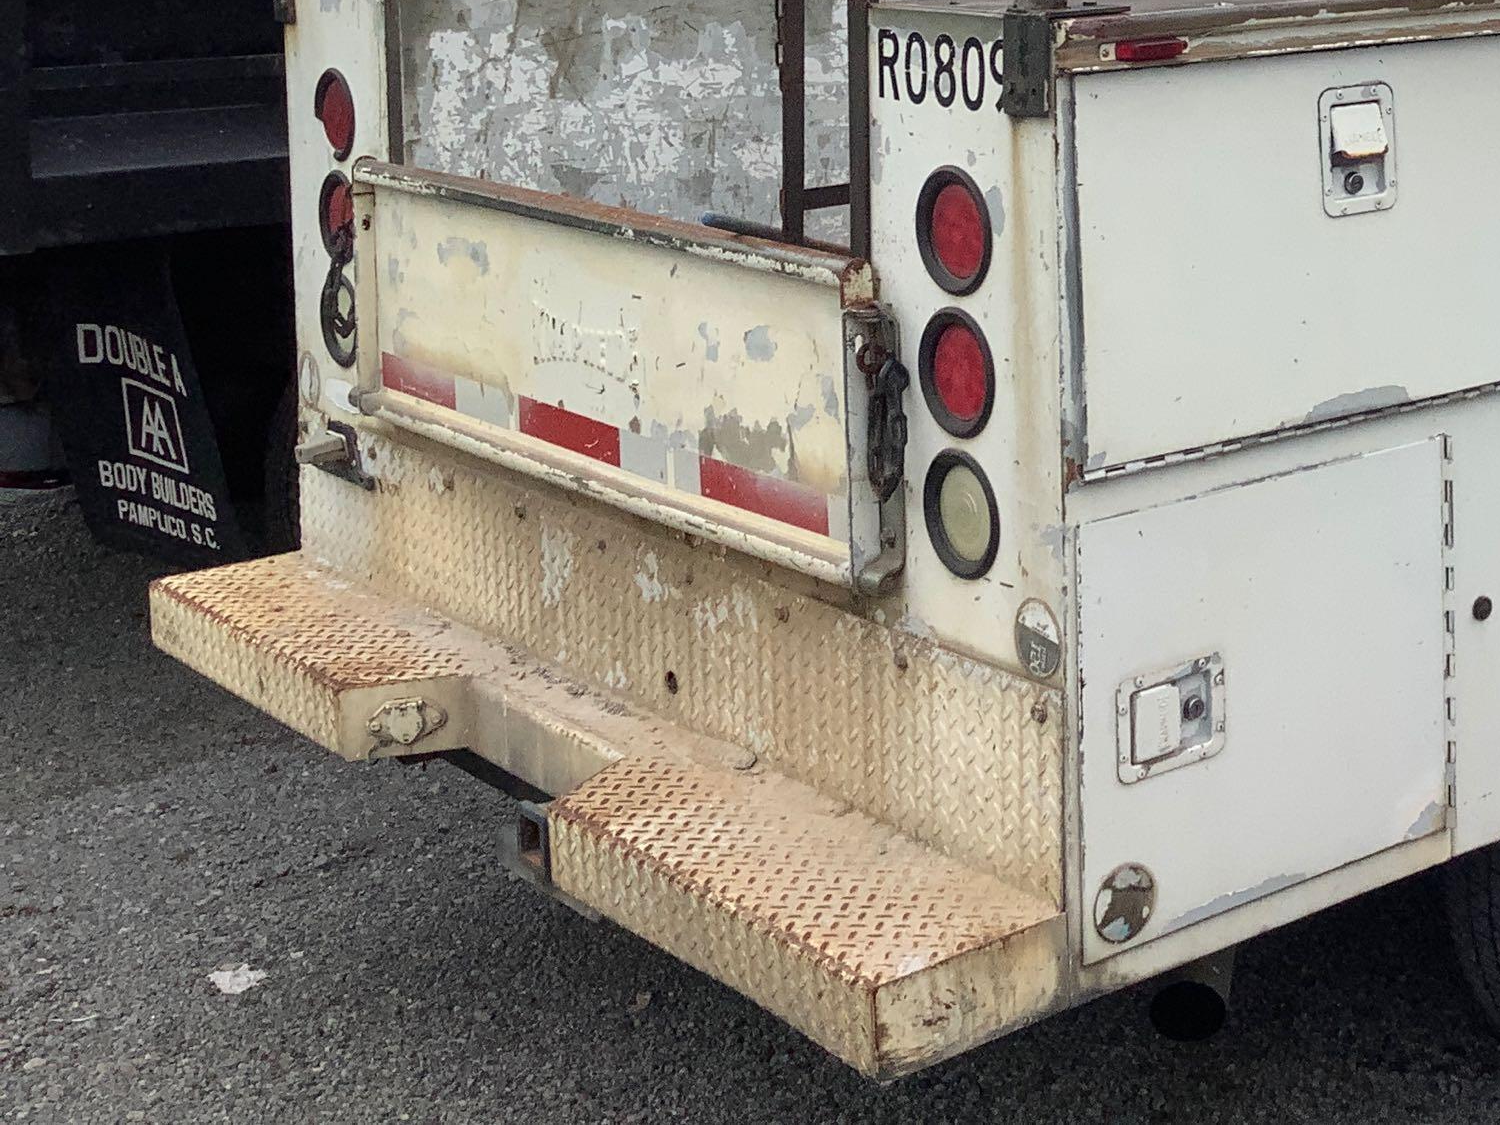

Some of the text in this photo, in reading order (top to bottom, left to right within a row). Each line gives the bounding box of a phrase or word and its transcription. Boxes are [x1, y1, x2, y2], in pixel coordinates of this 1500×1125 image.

[76, 323, 187, 397] DOUBLE A
[98, 460, 217, 521] BODY BUILDERS
[191, 524, 221, 550] S.C.
